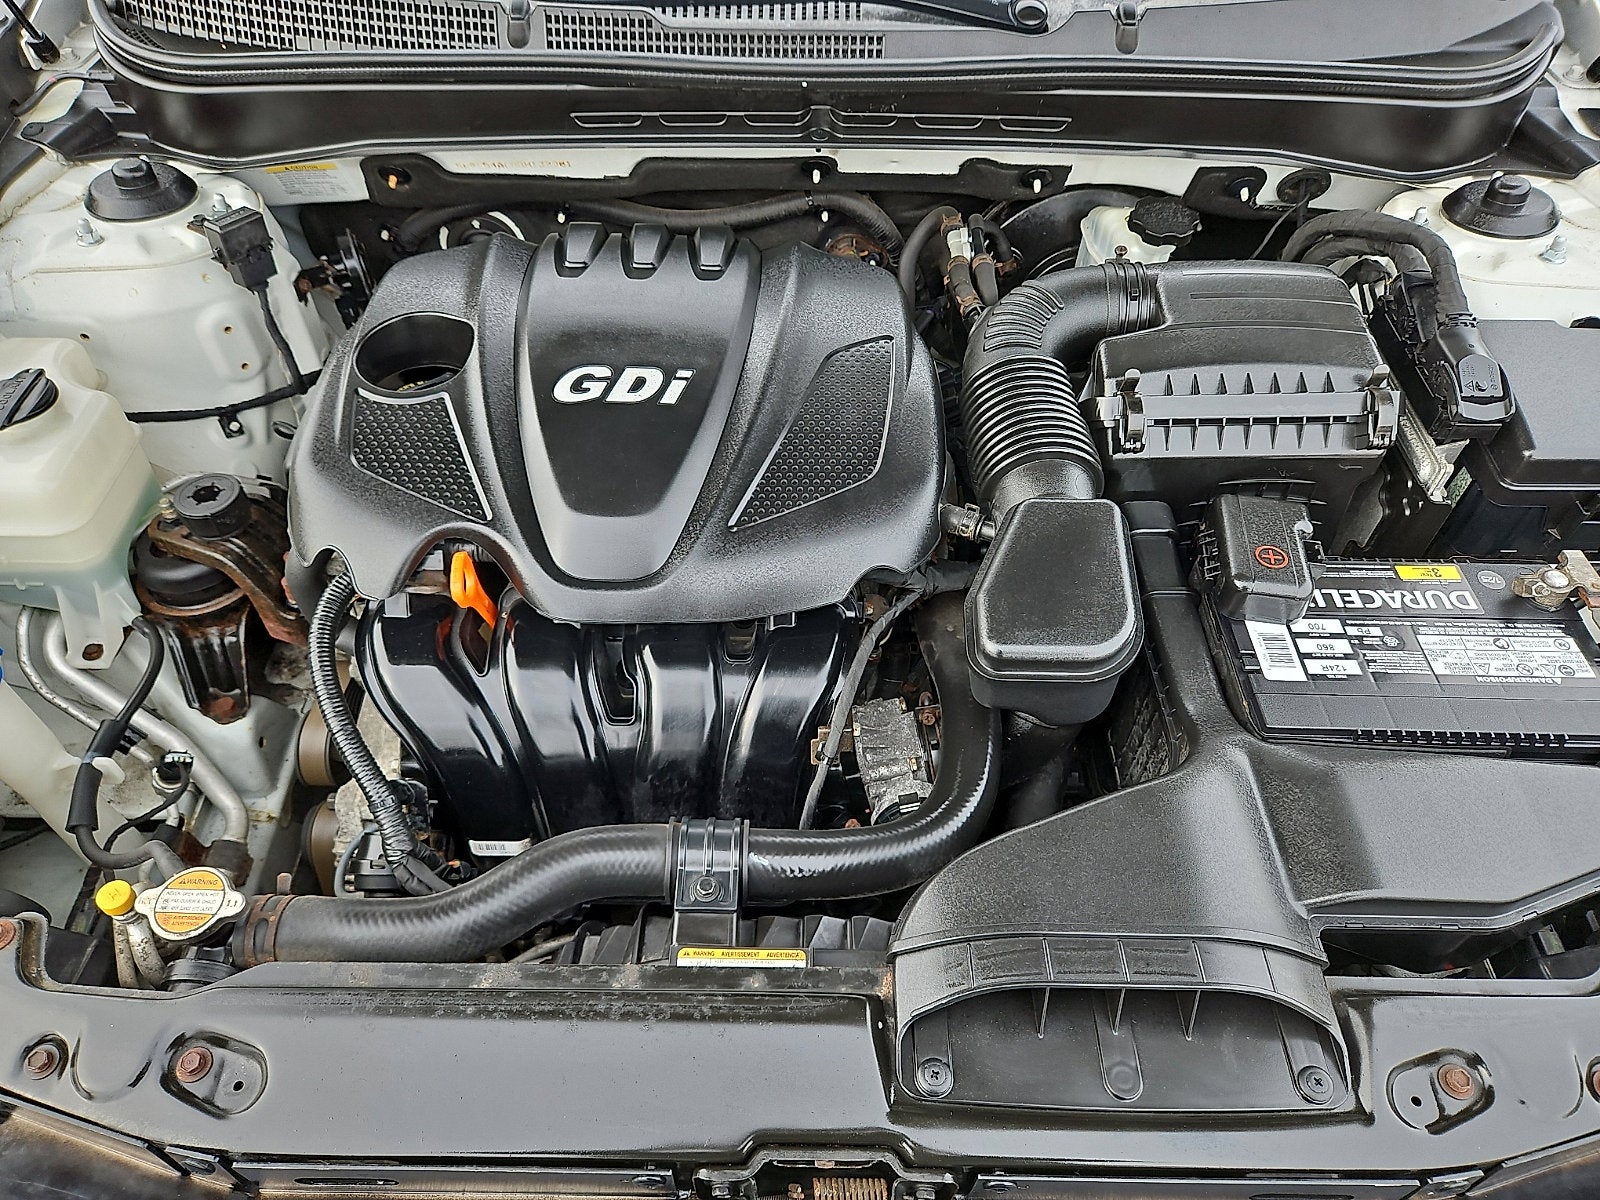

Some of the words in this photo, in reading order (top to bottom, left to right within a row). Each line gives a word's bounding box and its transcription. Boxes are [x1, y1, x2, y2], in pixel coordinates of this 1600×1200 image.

[551, 364, 696, 405] GDi
[1431, 567, 1442, 578] 3
[1480, 575, 1502, 584] 1/25
[1307, 622, 1326, 631] 700
[1356, 627, 1372, 635] Pb
[1316, 643, 1335, 652] 860
[1320, 663, 1348, 672] 124R
